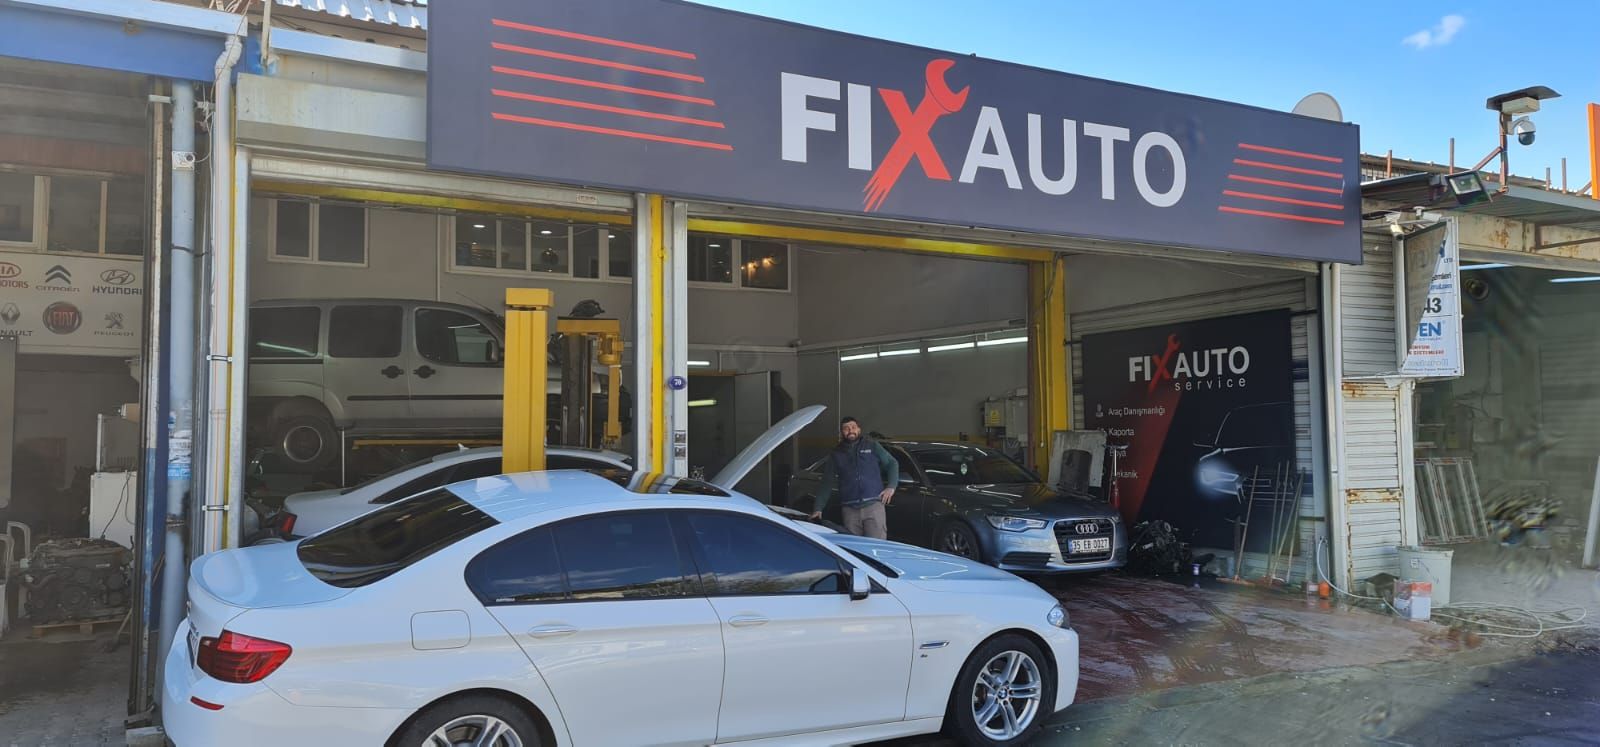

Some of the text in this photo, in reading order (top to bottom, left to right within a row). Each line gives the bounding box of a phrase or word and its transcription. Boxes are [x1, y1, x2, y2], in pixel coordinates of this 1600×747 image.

[781, 58, 1187, 212] FIXAUTO
[0, 265, 15, 275] IA
[0, 280, 29, 288] OTORS
[92, 285, 143, 295] HYUNDAI
[53, 311, 75, 324] FIAT
[0, 329, 33, 337] NAULT
[1418, 322, 1442, 337] EN
[1128, 334, 1250, 392] FIXAUTO
[1175, 376, 1246, 391] service
[1108, 428, 1135, 437] Kaporta
[1115, 470, 1138, 479] ekanik
[1072, 540, 1081, 550] 35
